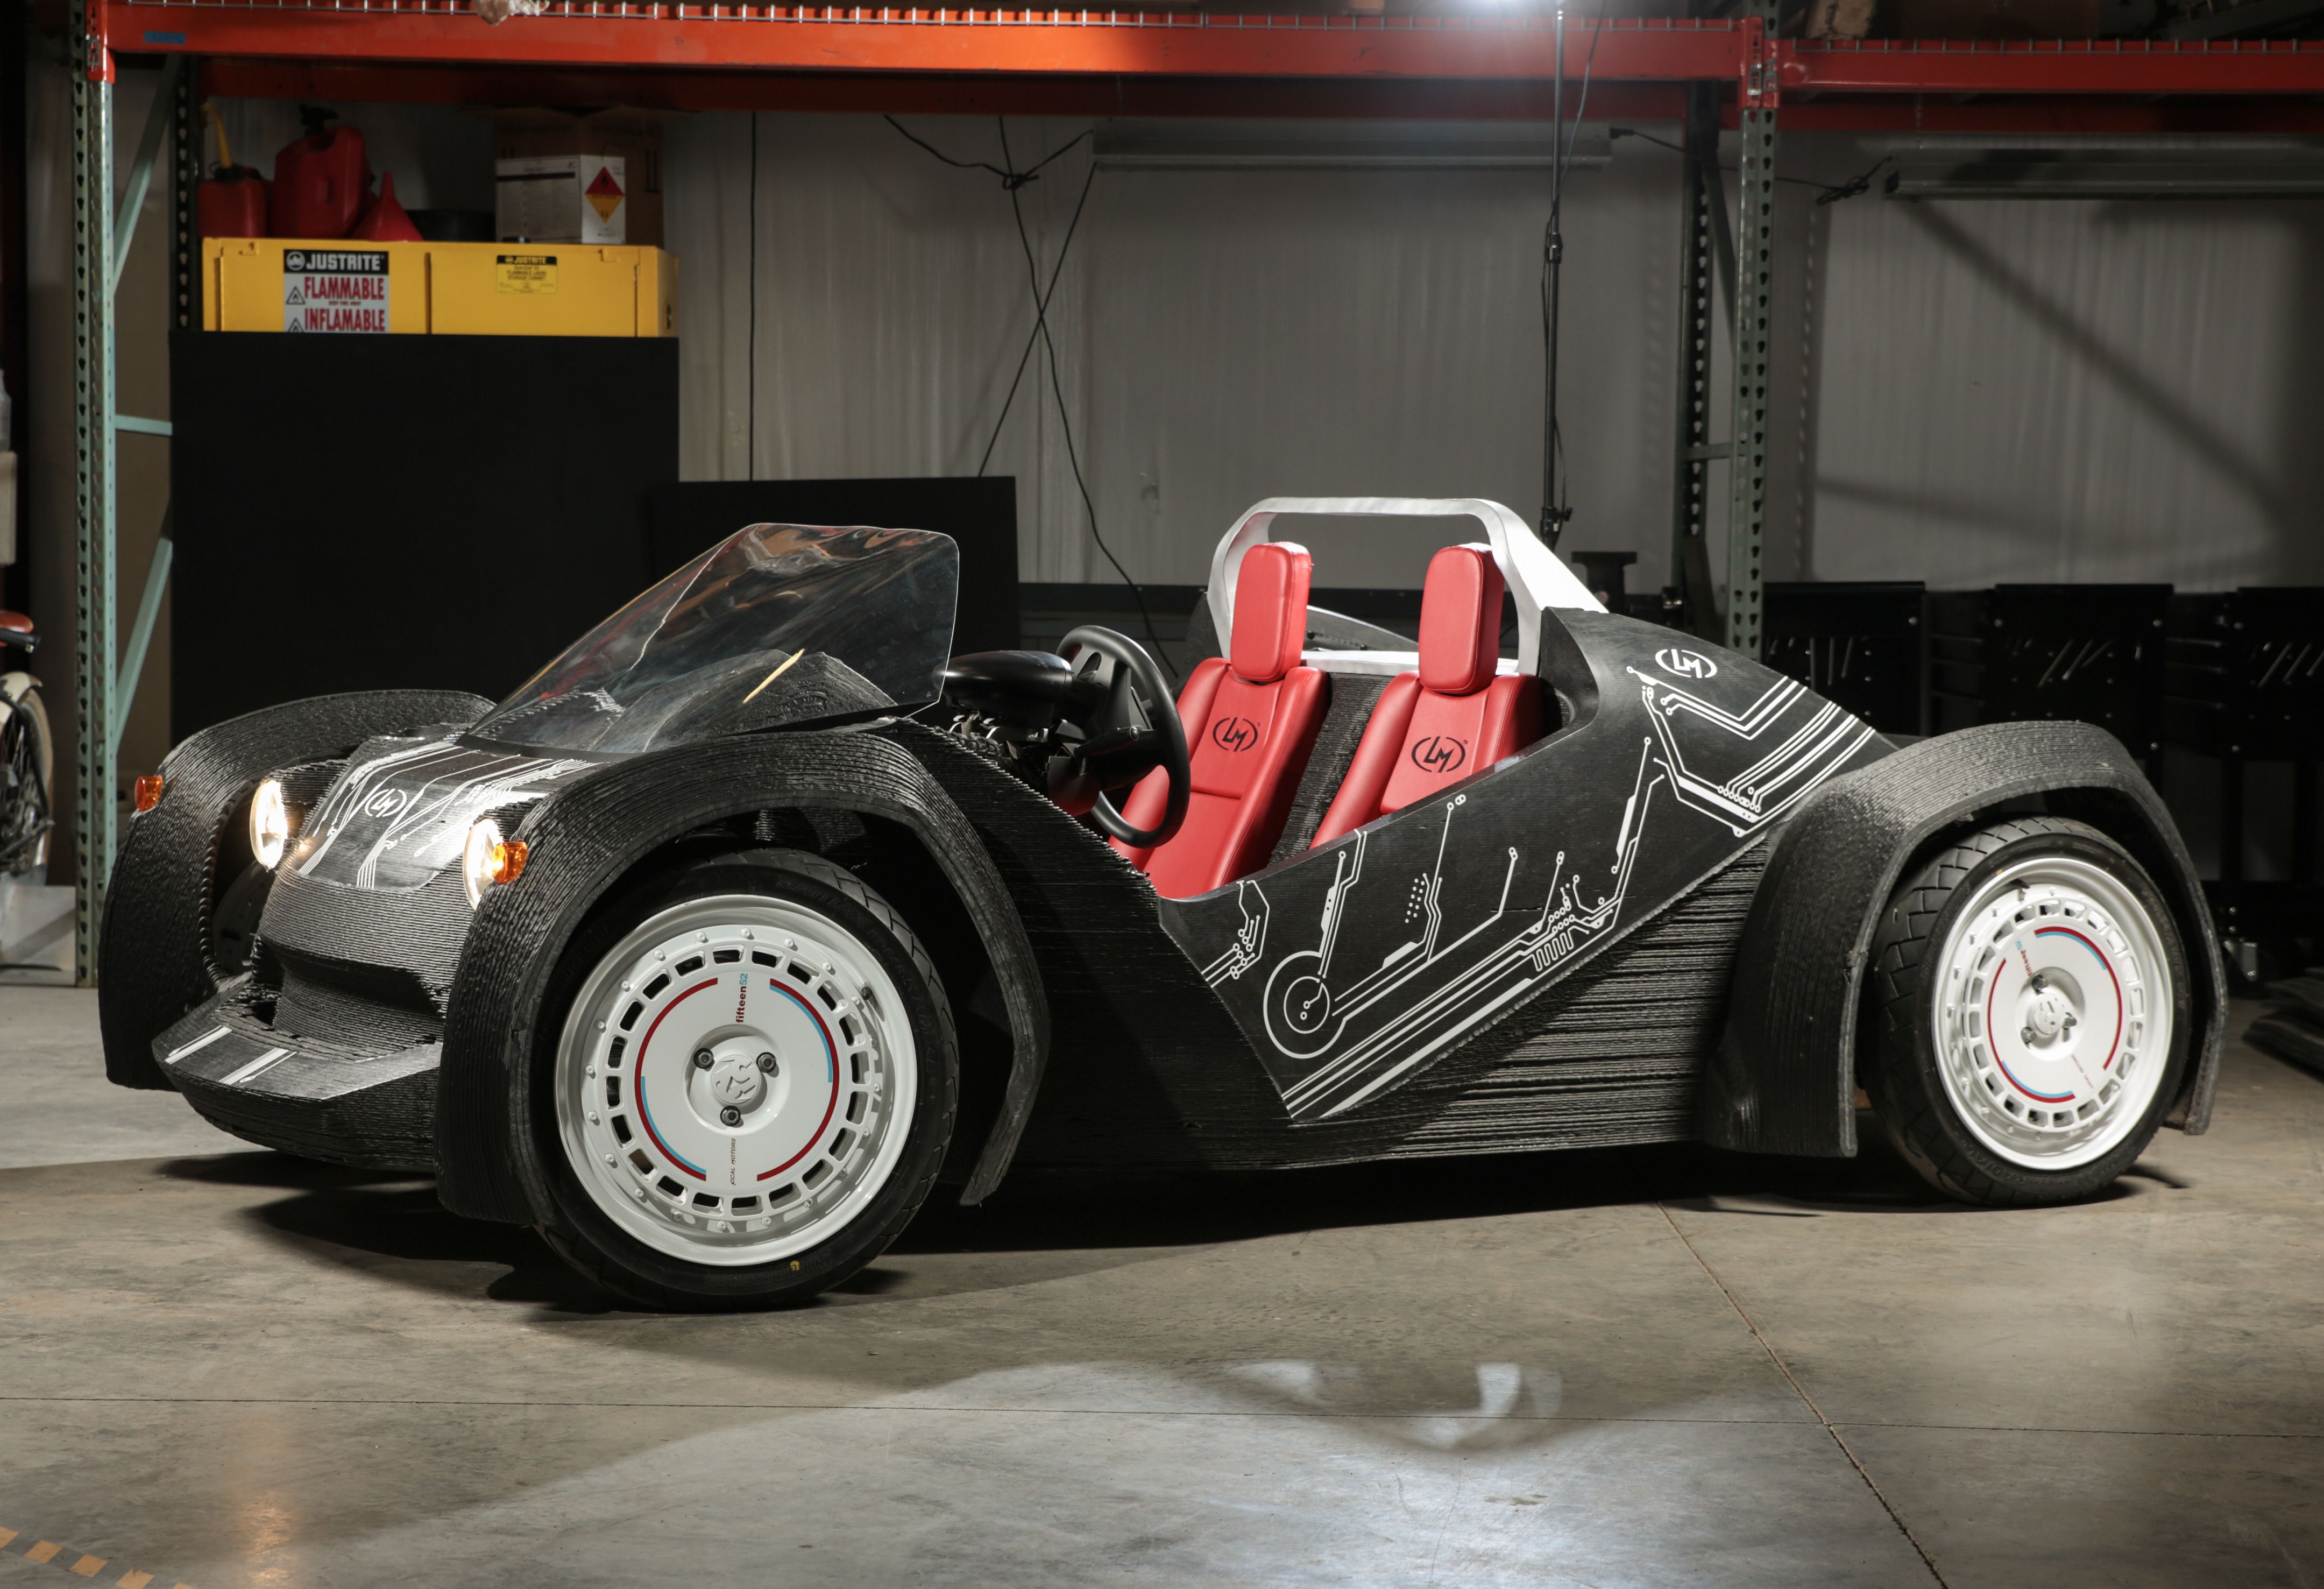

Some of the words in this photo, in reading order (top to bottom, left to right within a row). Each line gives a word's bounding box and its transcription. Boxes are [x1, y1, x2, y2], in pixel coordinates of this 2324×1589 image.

[306, 253, 381, 271] JUSTRITE
[514, 256, 547, 264] JUSTRITE
[305, 277, 384, 300] FLAMMABLE
[305, 308, 385, 332] INFLAMABLE
[736, 973, 748, 1023] fifteen52
